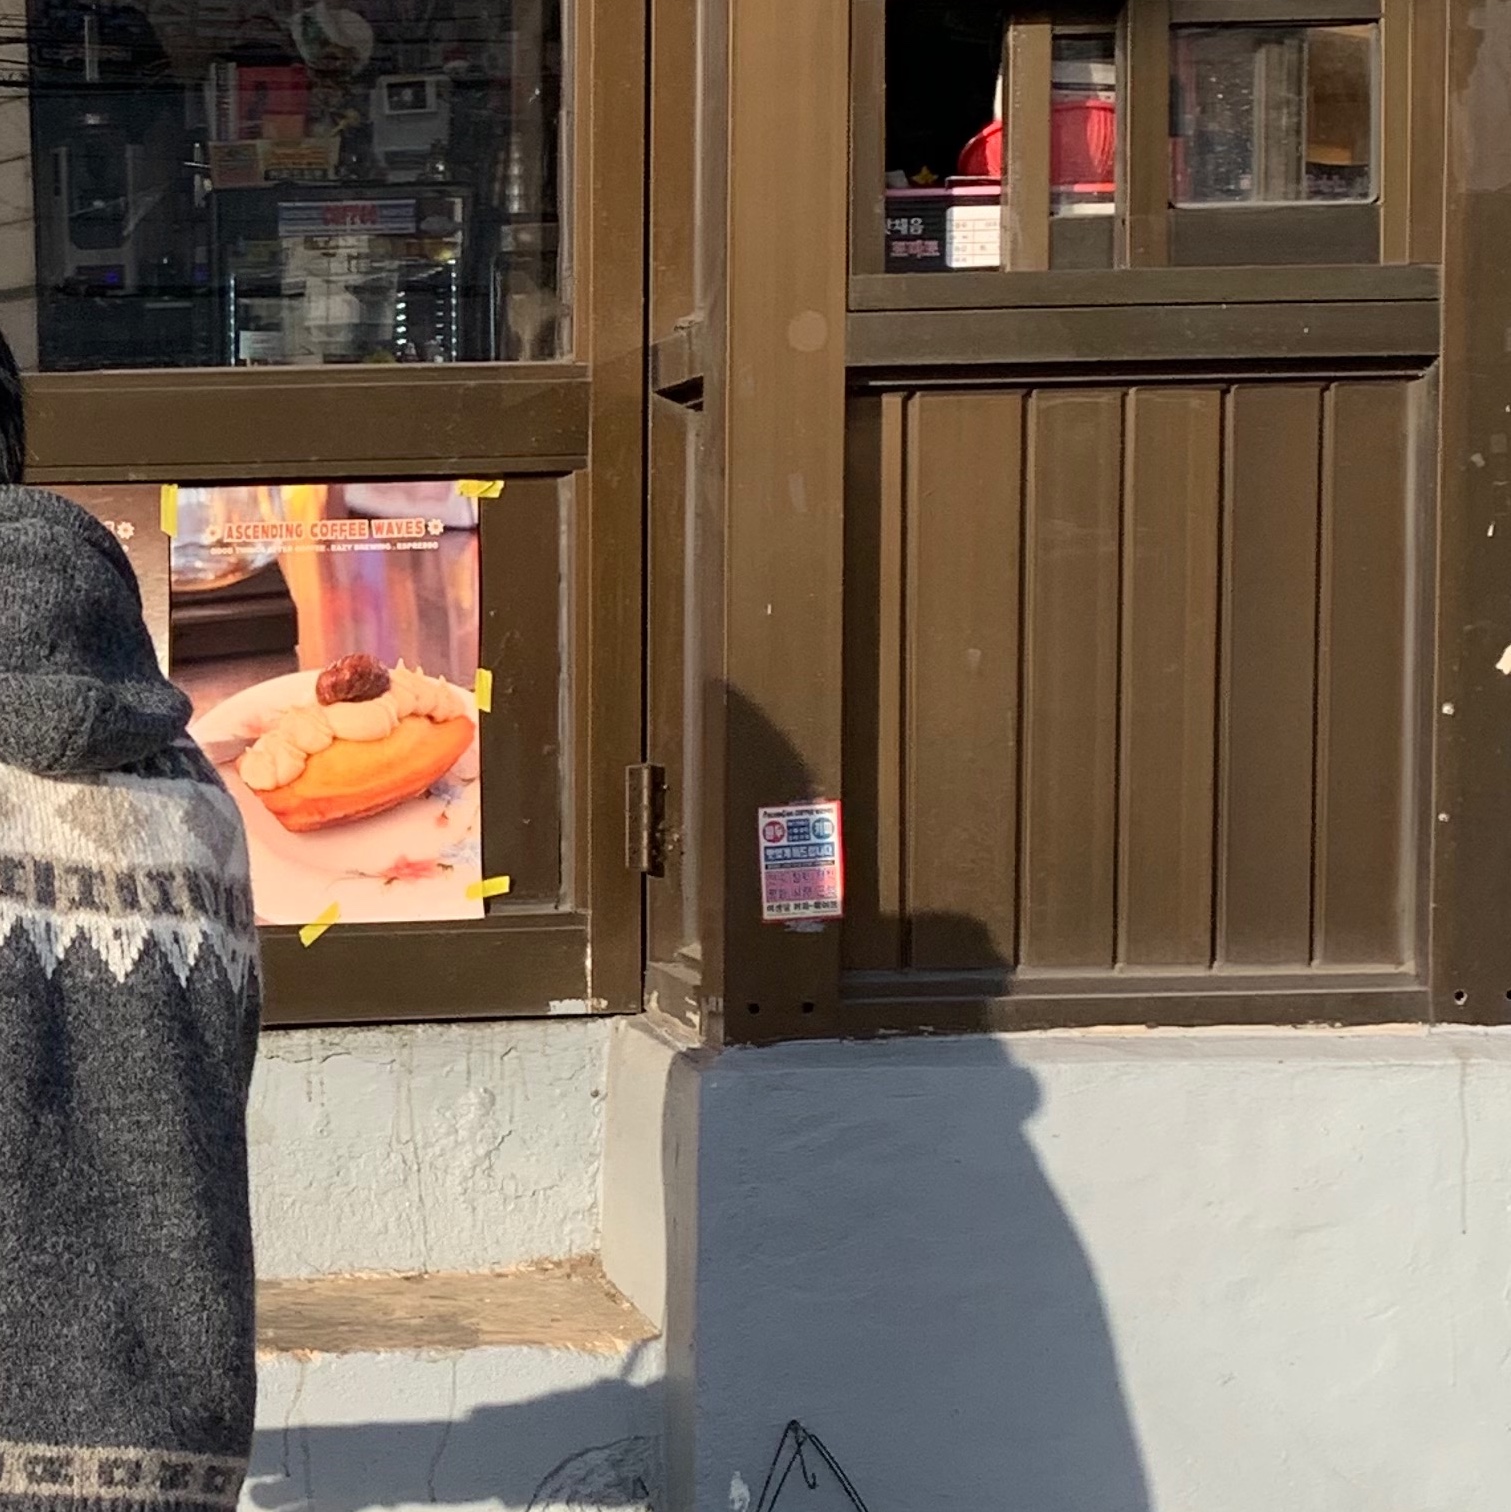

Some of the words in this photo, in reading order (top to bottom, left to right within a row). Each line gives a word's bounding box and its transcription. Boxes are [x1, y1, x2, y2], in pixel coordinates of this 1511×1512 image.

[224, 522, 304, 541] ASCENDING
[310, 520, 368, 538] COFFEE
[373, 519, 424, 536] WAVES
